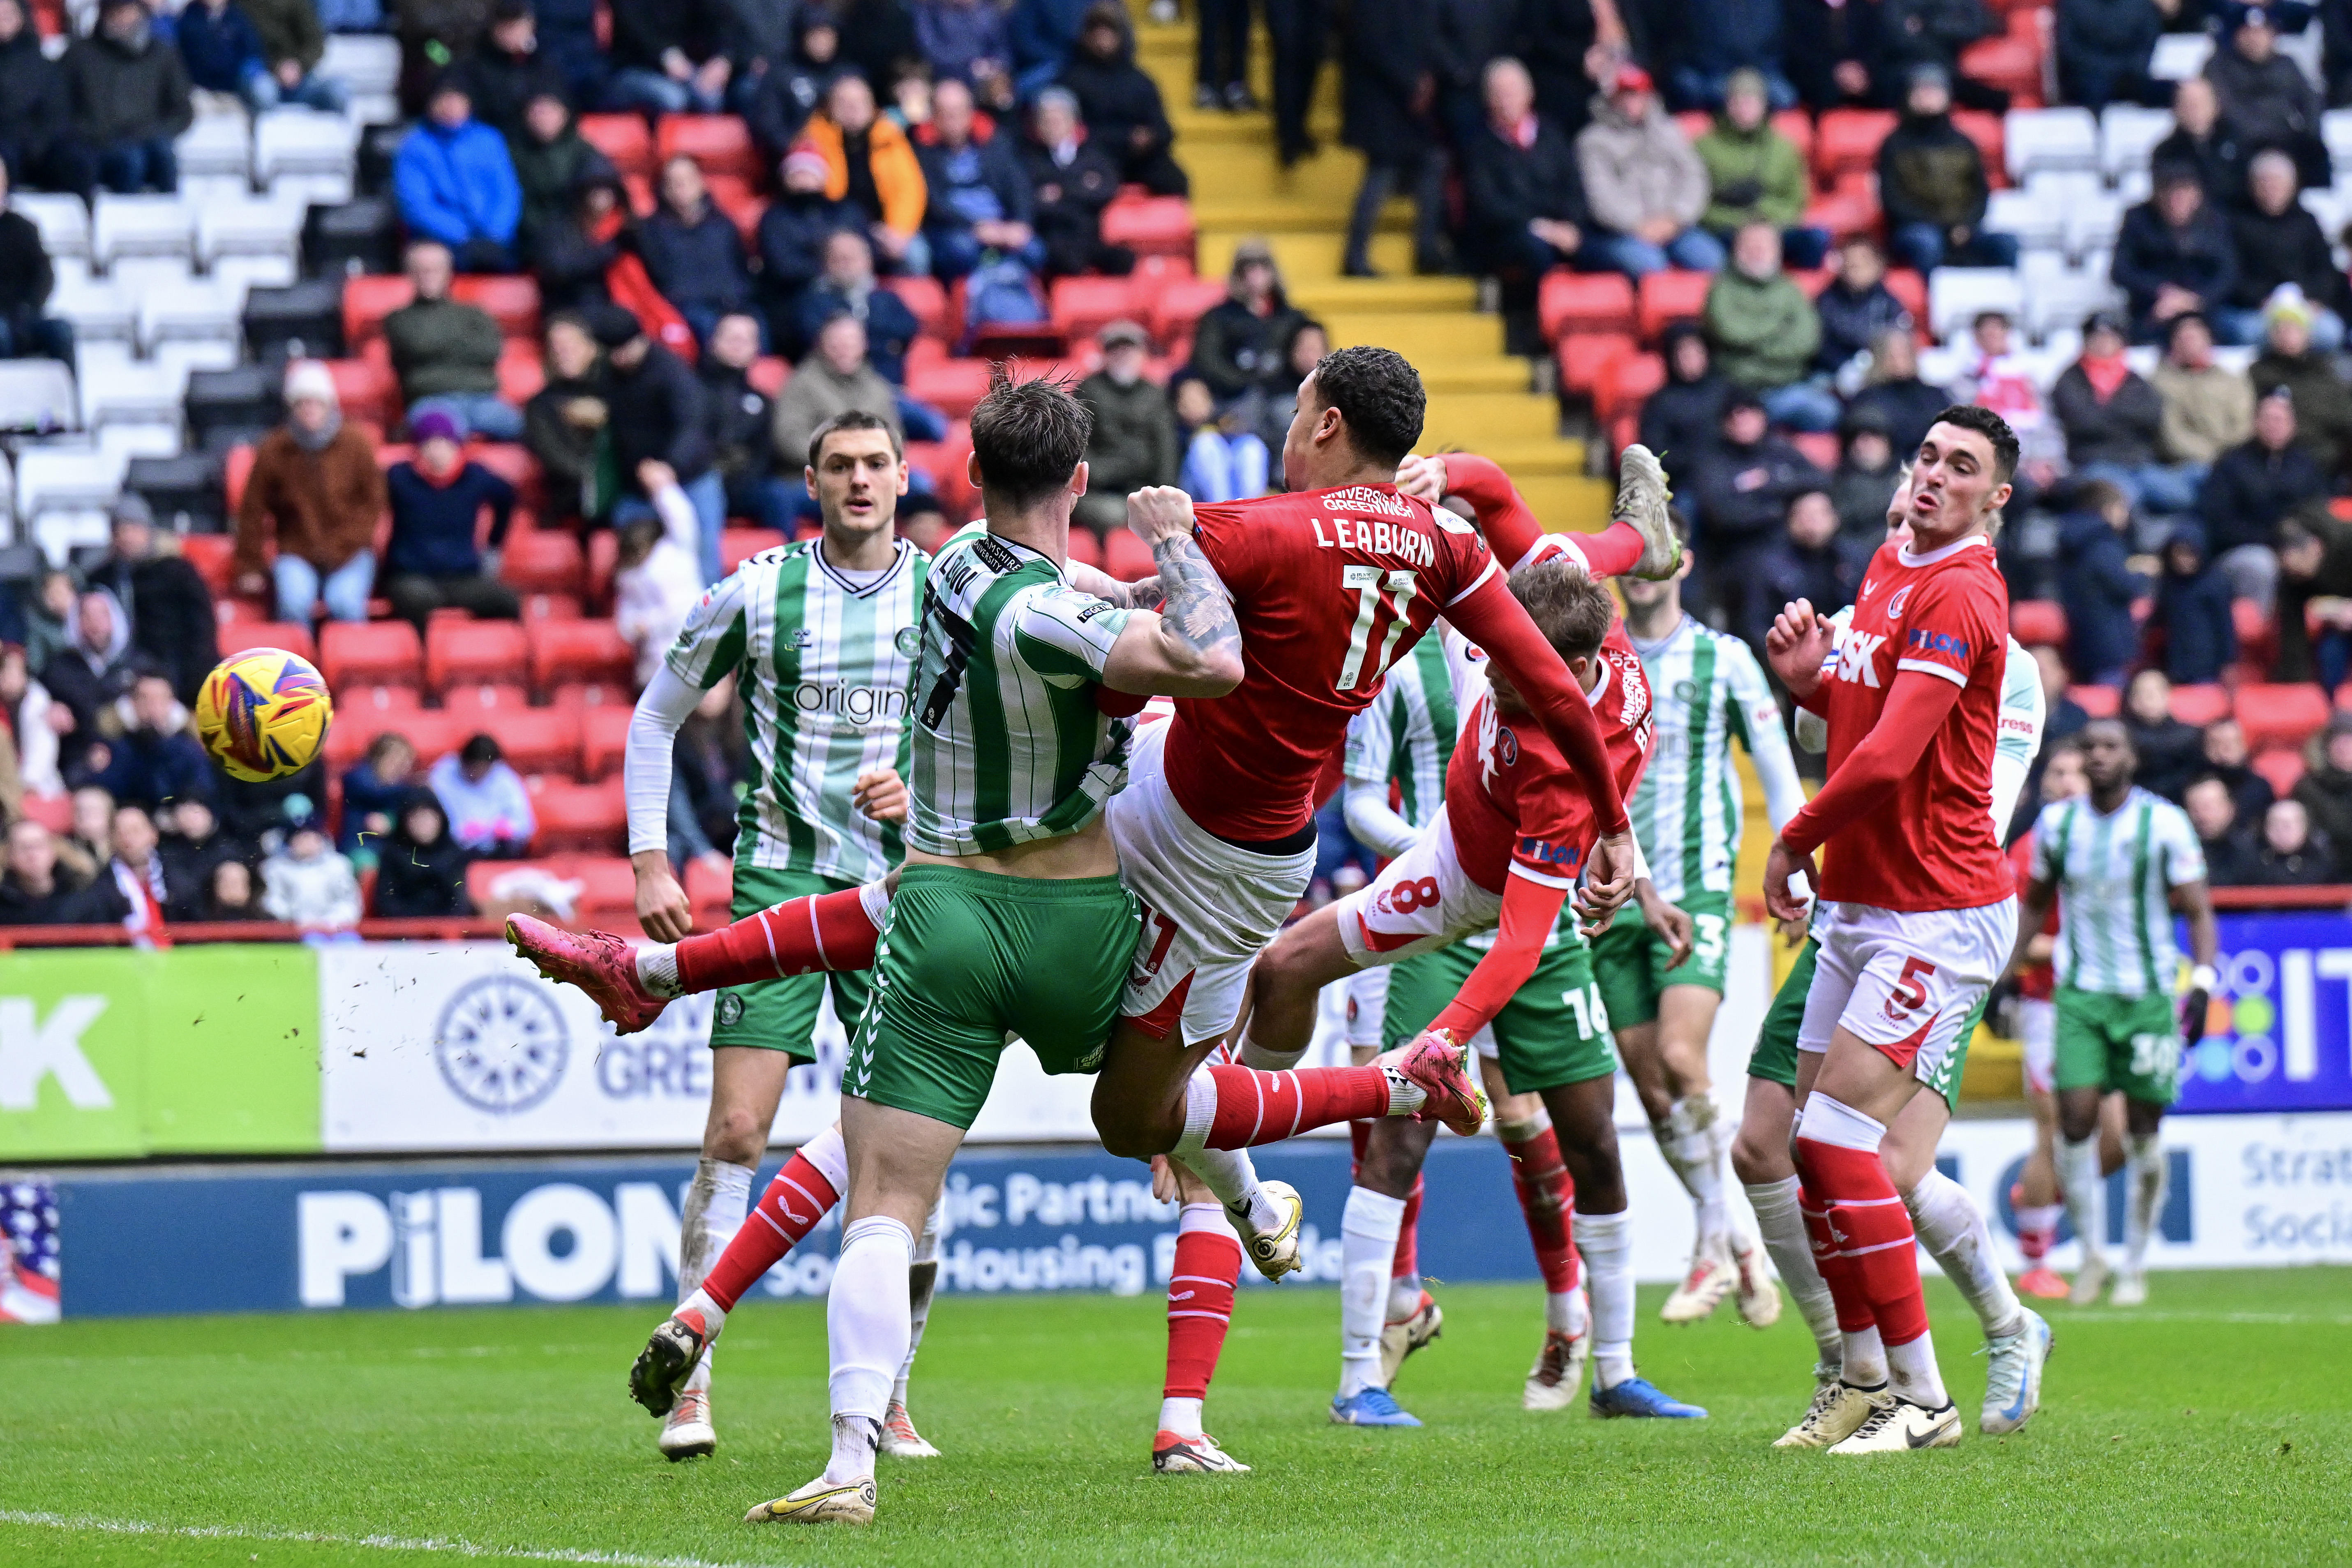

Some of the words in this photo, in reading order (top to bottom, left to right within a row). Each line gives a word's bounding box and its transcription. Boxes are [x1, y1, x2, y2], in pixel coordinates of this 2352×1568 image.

[1323, 499, 1415, 520] GREENWICH
[1311, 518, 1434, 567] LEABURN
[1078, 604, 1115, 620] TOGETH
[1336, 565, 1419, 690] 11
[796, 679, 906, 725] origin
[1620, 674, 1636, 726] UNIVERS
[1391, 876, 1441, 914] 8
[1694, 913, 1726, 959] 3
[1890, 956, 1936, 1009] 5
[1561, 981, 1610, 1041] 16
[1005, 1171, 1180, 1226] Partne
[937, 1233, 1147, 1297] Housing
[828, 1489, 854, 1497] TIEMPO
